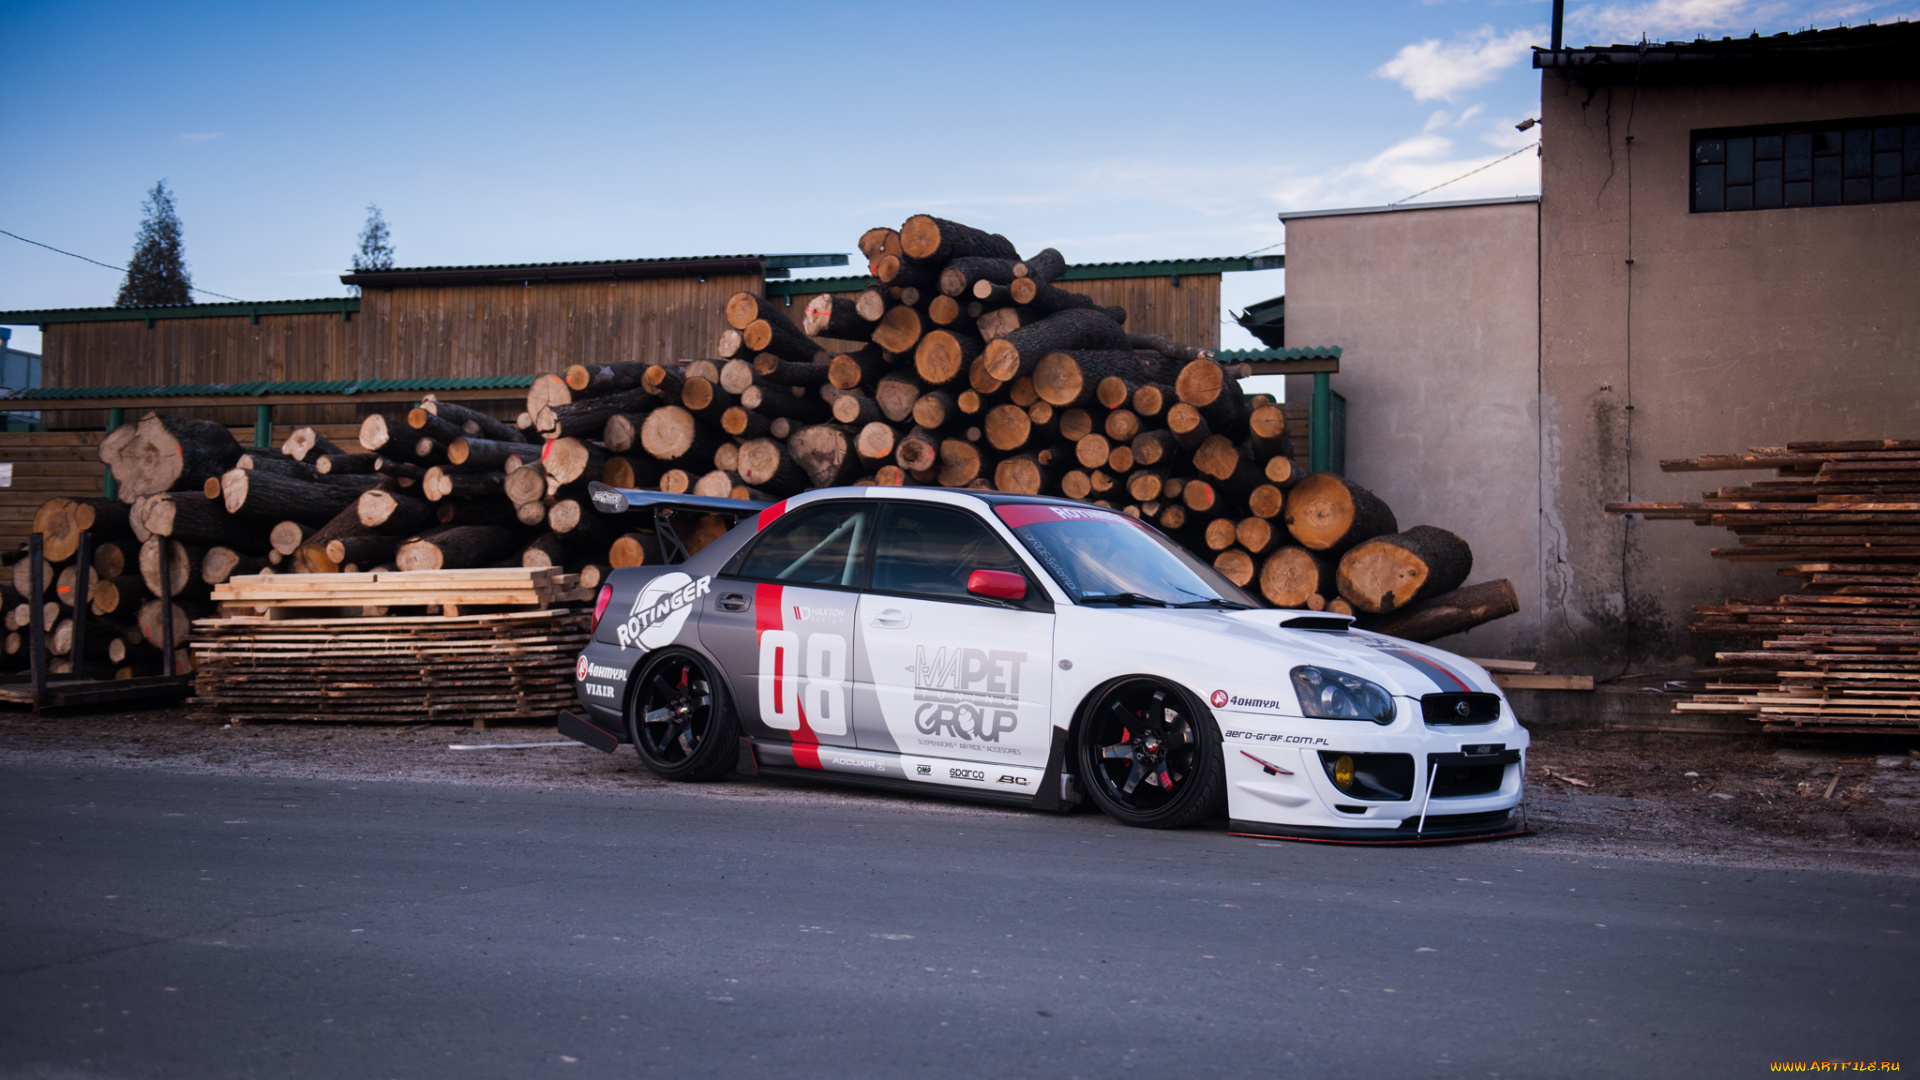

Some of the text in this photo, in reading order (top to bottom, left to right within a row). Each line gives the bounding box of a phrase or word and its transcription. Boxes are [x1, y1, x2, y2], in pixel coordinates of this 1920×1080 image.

[616, 575, 711, 651] ROTINGER
[811, 607, 846, 617] MAXTON
[758, 629, 848, 736] 08
[586, 683, 615, 698] VIAIR
[922, 690, 1013, 706] TUNING
[914, 702, 1018, 743] GROUP
[832, 757, 875, 768] ACCUAIR
[916, 766, 932, 774] OMP
[949, 768, 985, 780] sparco
